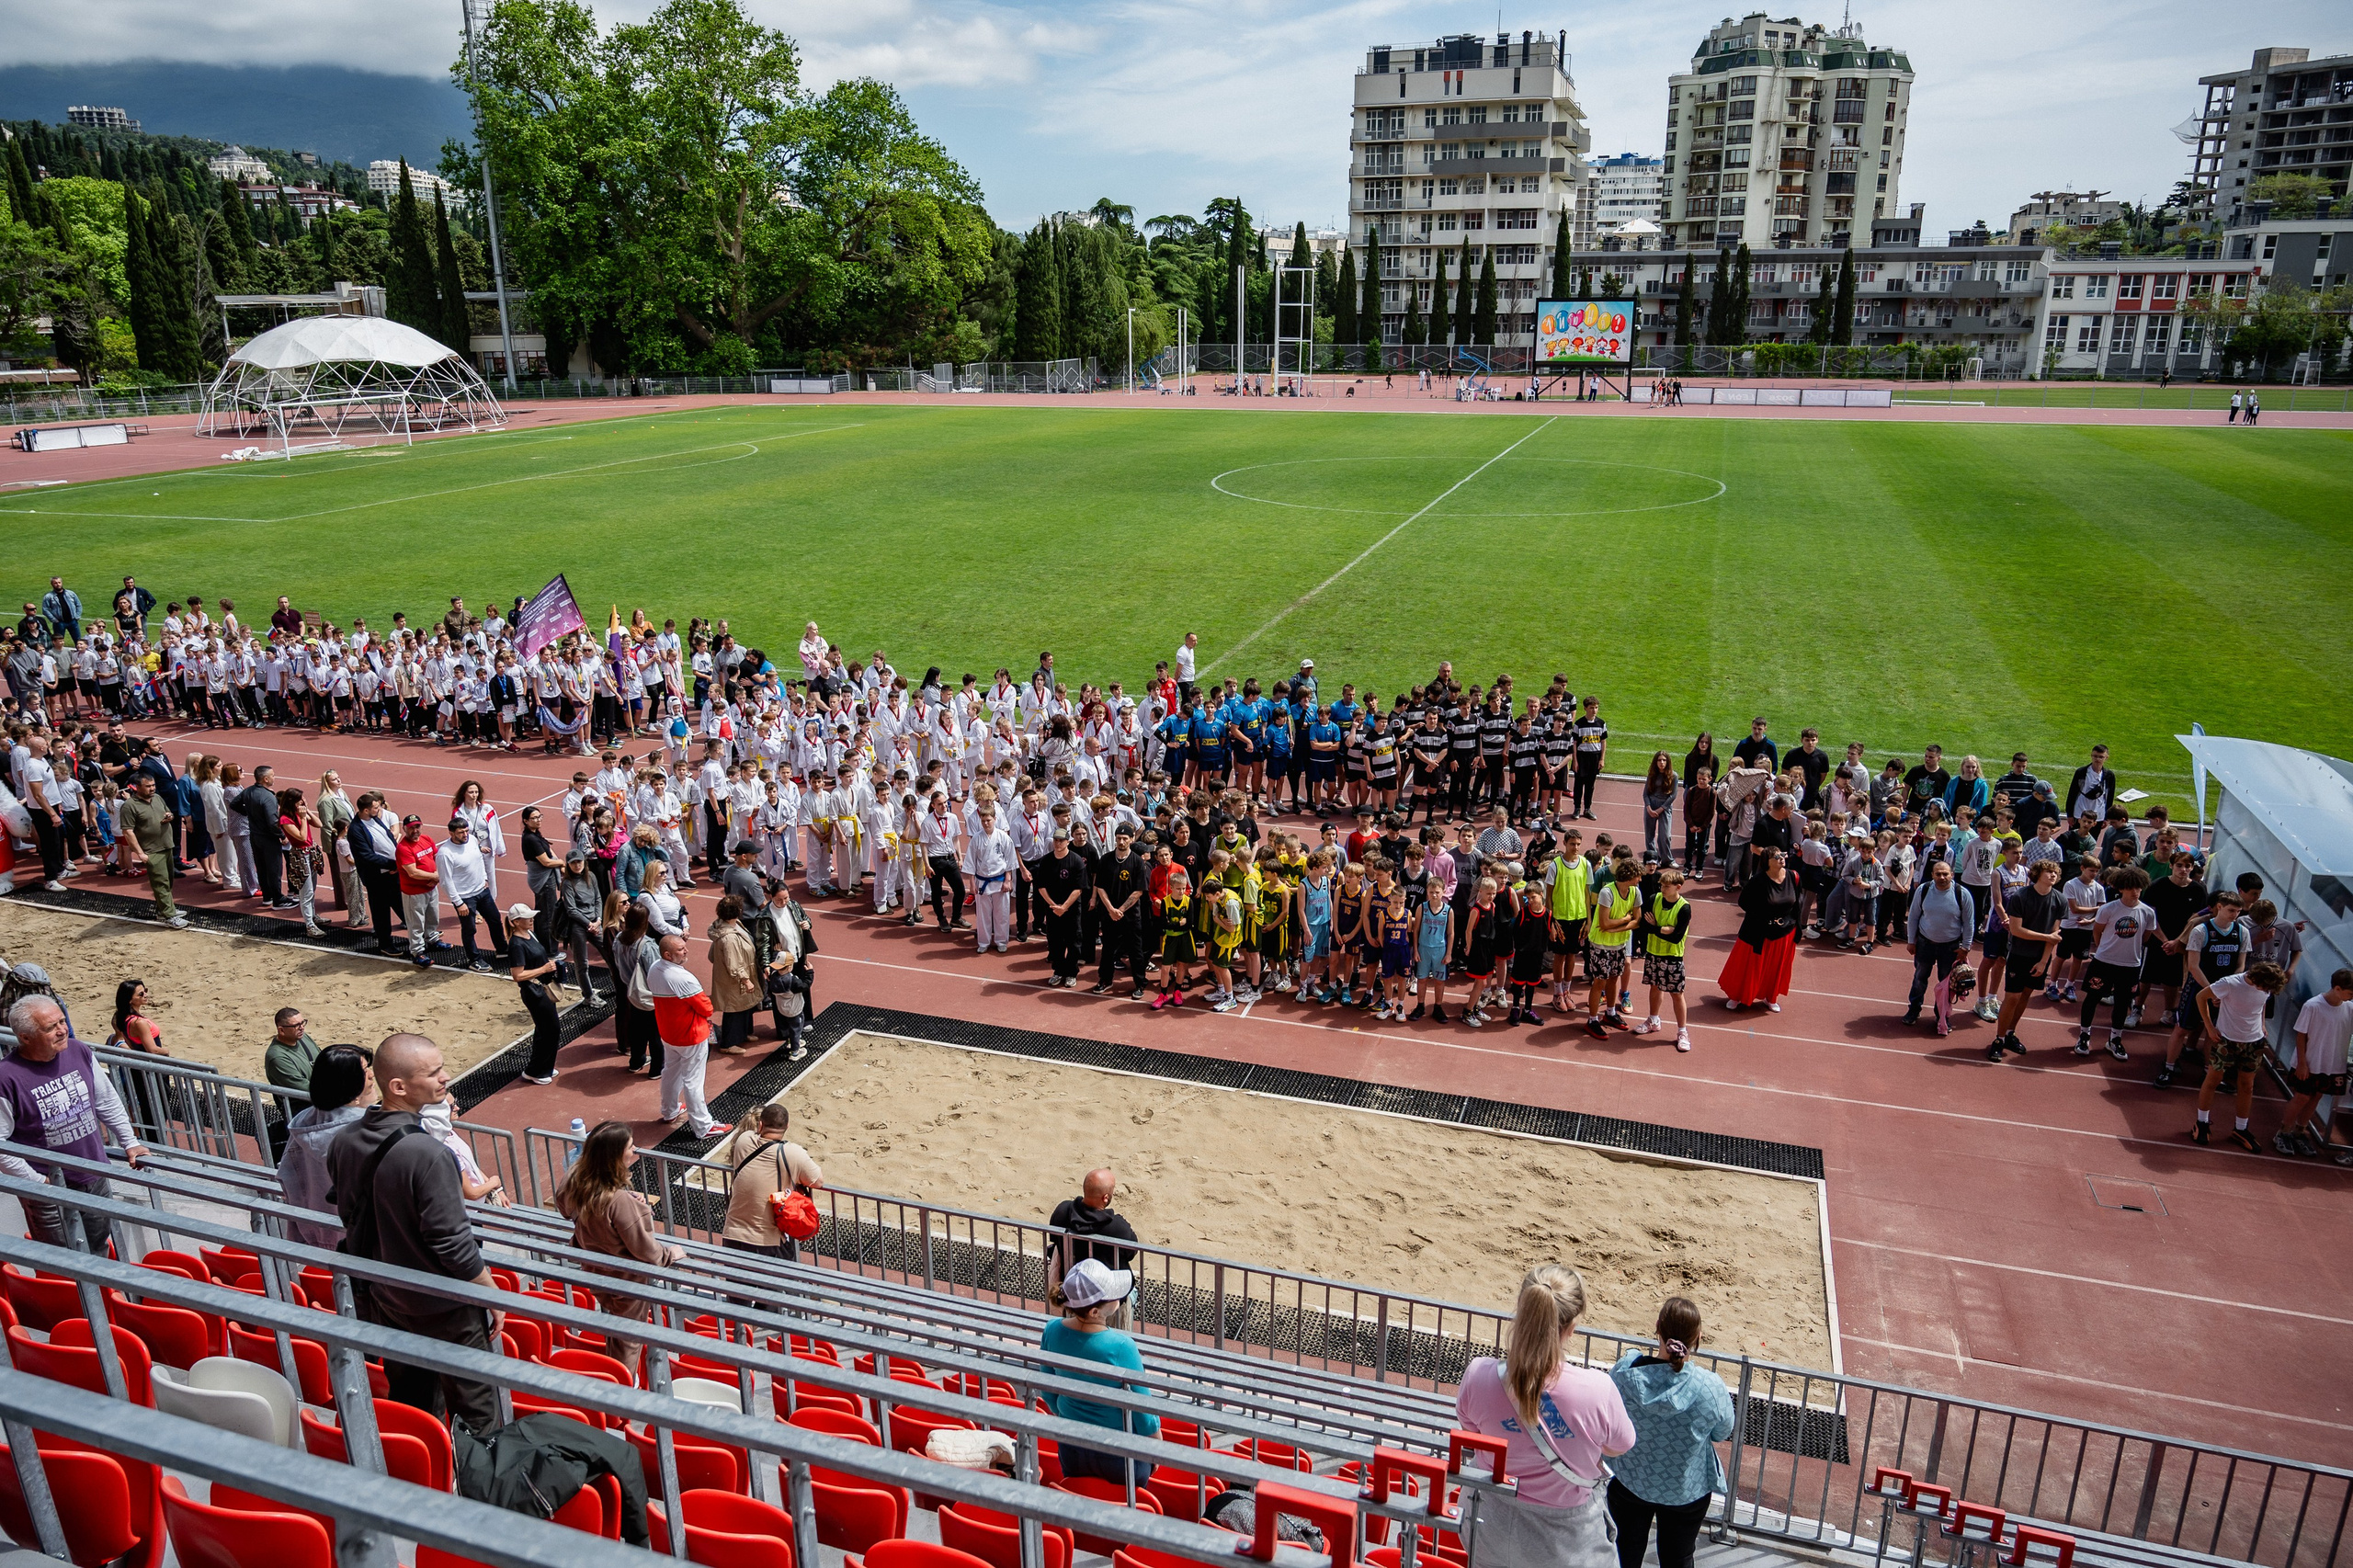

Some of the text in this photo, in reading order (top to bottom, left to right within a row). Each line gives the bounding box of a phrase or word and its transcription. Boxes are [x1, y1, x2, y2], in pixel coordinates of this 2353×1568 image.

[1265, 901, 1278, 913] 55
[1409, 895, 1416, 908] 7
[1391, 930, 1401, 939] 33
[1428, 926, 1438, 936] 77
[2209, 944, 2239, 952] AIRKIDS
[1435, 971, 1445, 979] 77
[30, 1078, 64, 1099] TRACK
[40, 1101, 72, 1119] IT UP
[62, 1120, 97, 1145] BLEED
